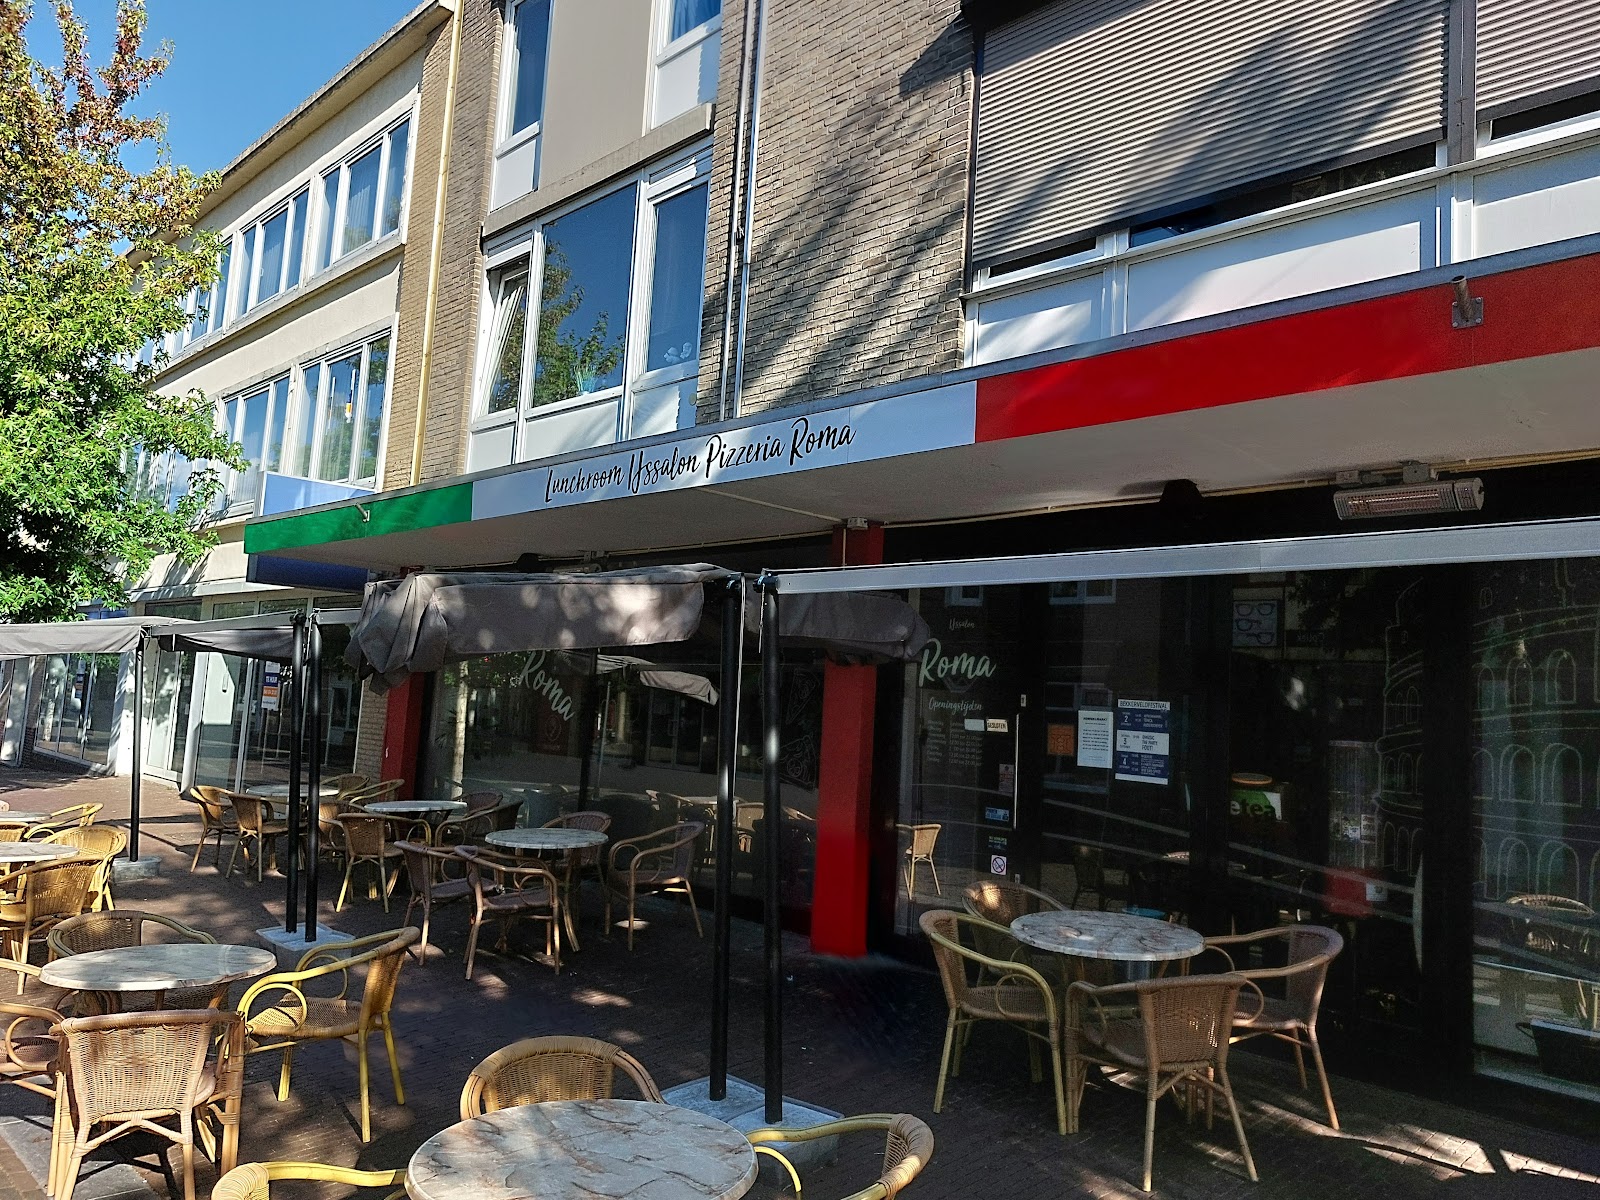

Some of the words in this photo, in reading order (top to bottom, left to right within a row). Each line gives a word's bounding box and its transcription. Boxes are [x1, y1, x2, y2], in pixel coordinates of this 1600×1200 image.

[545, 465, 626, 503] Lunchroom
[705, 434, 786, 478] Pizzeria
[789, 417, 857, 466] Roma
[518, 650, 576, 722] Roma
[918, 638, 997, 687] Roma
[1120, 700, 1168, 708] BEKKERVELDFESTIVAL
